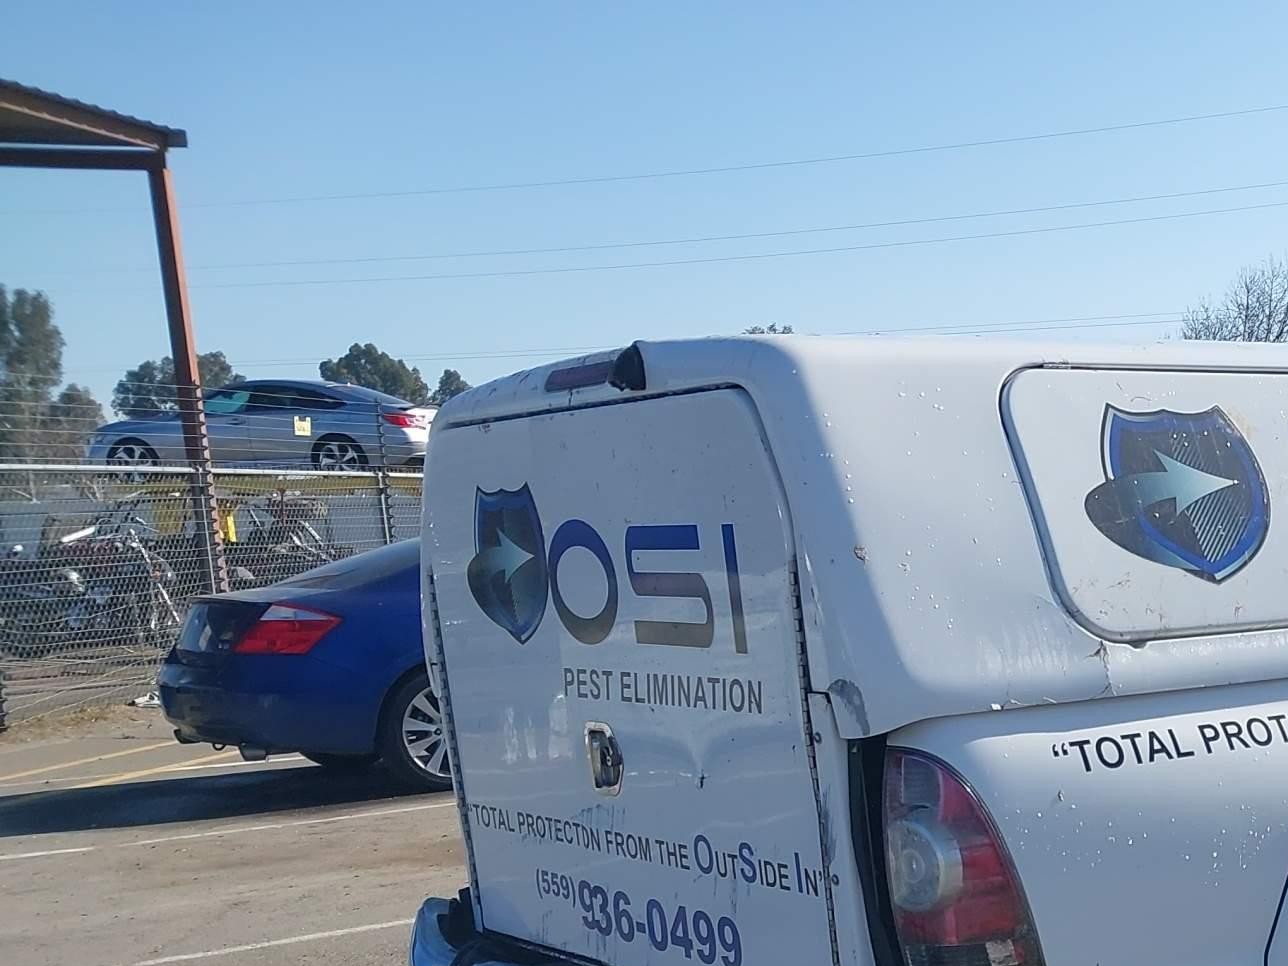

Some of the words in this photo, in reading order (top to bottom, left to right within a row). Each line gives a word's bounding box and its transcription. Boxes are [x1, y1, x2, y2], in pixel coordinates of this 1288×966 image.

[548, 519, 749, 654] OSI
[563, 667, 613, 700] PEST
[619, 671, 763, 714] ELIMINATION
[605, 830, 652, 863] FROM
[655, 839, 690, 871] THE
[536, 868, 577, 908] (559)
